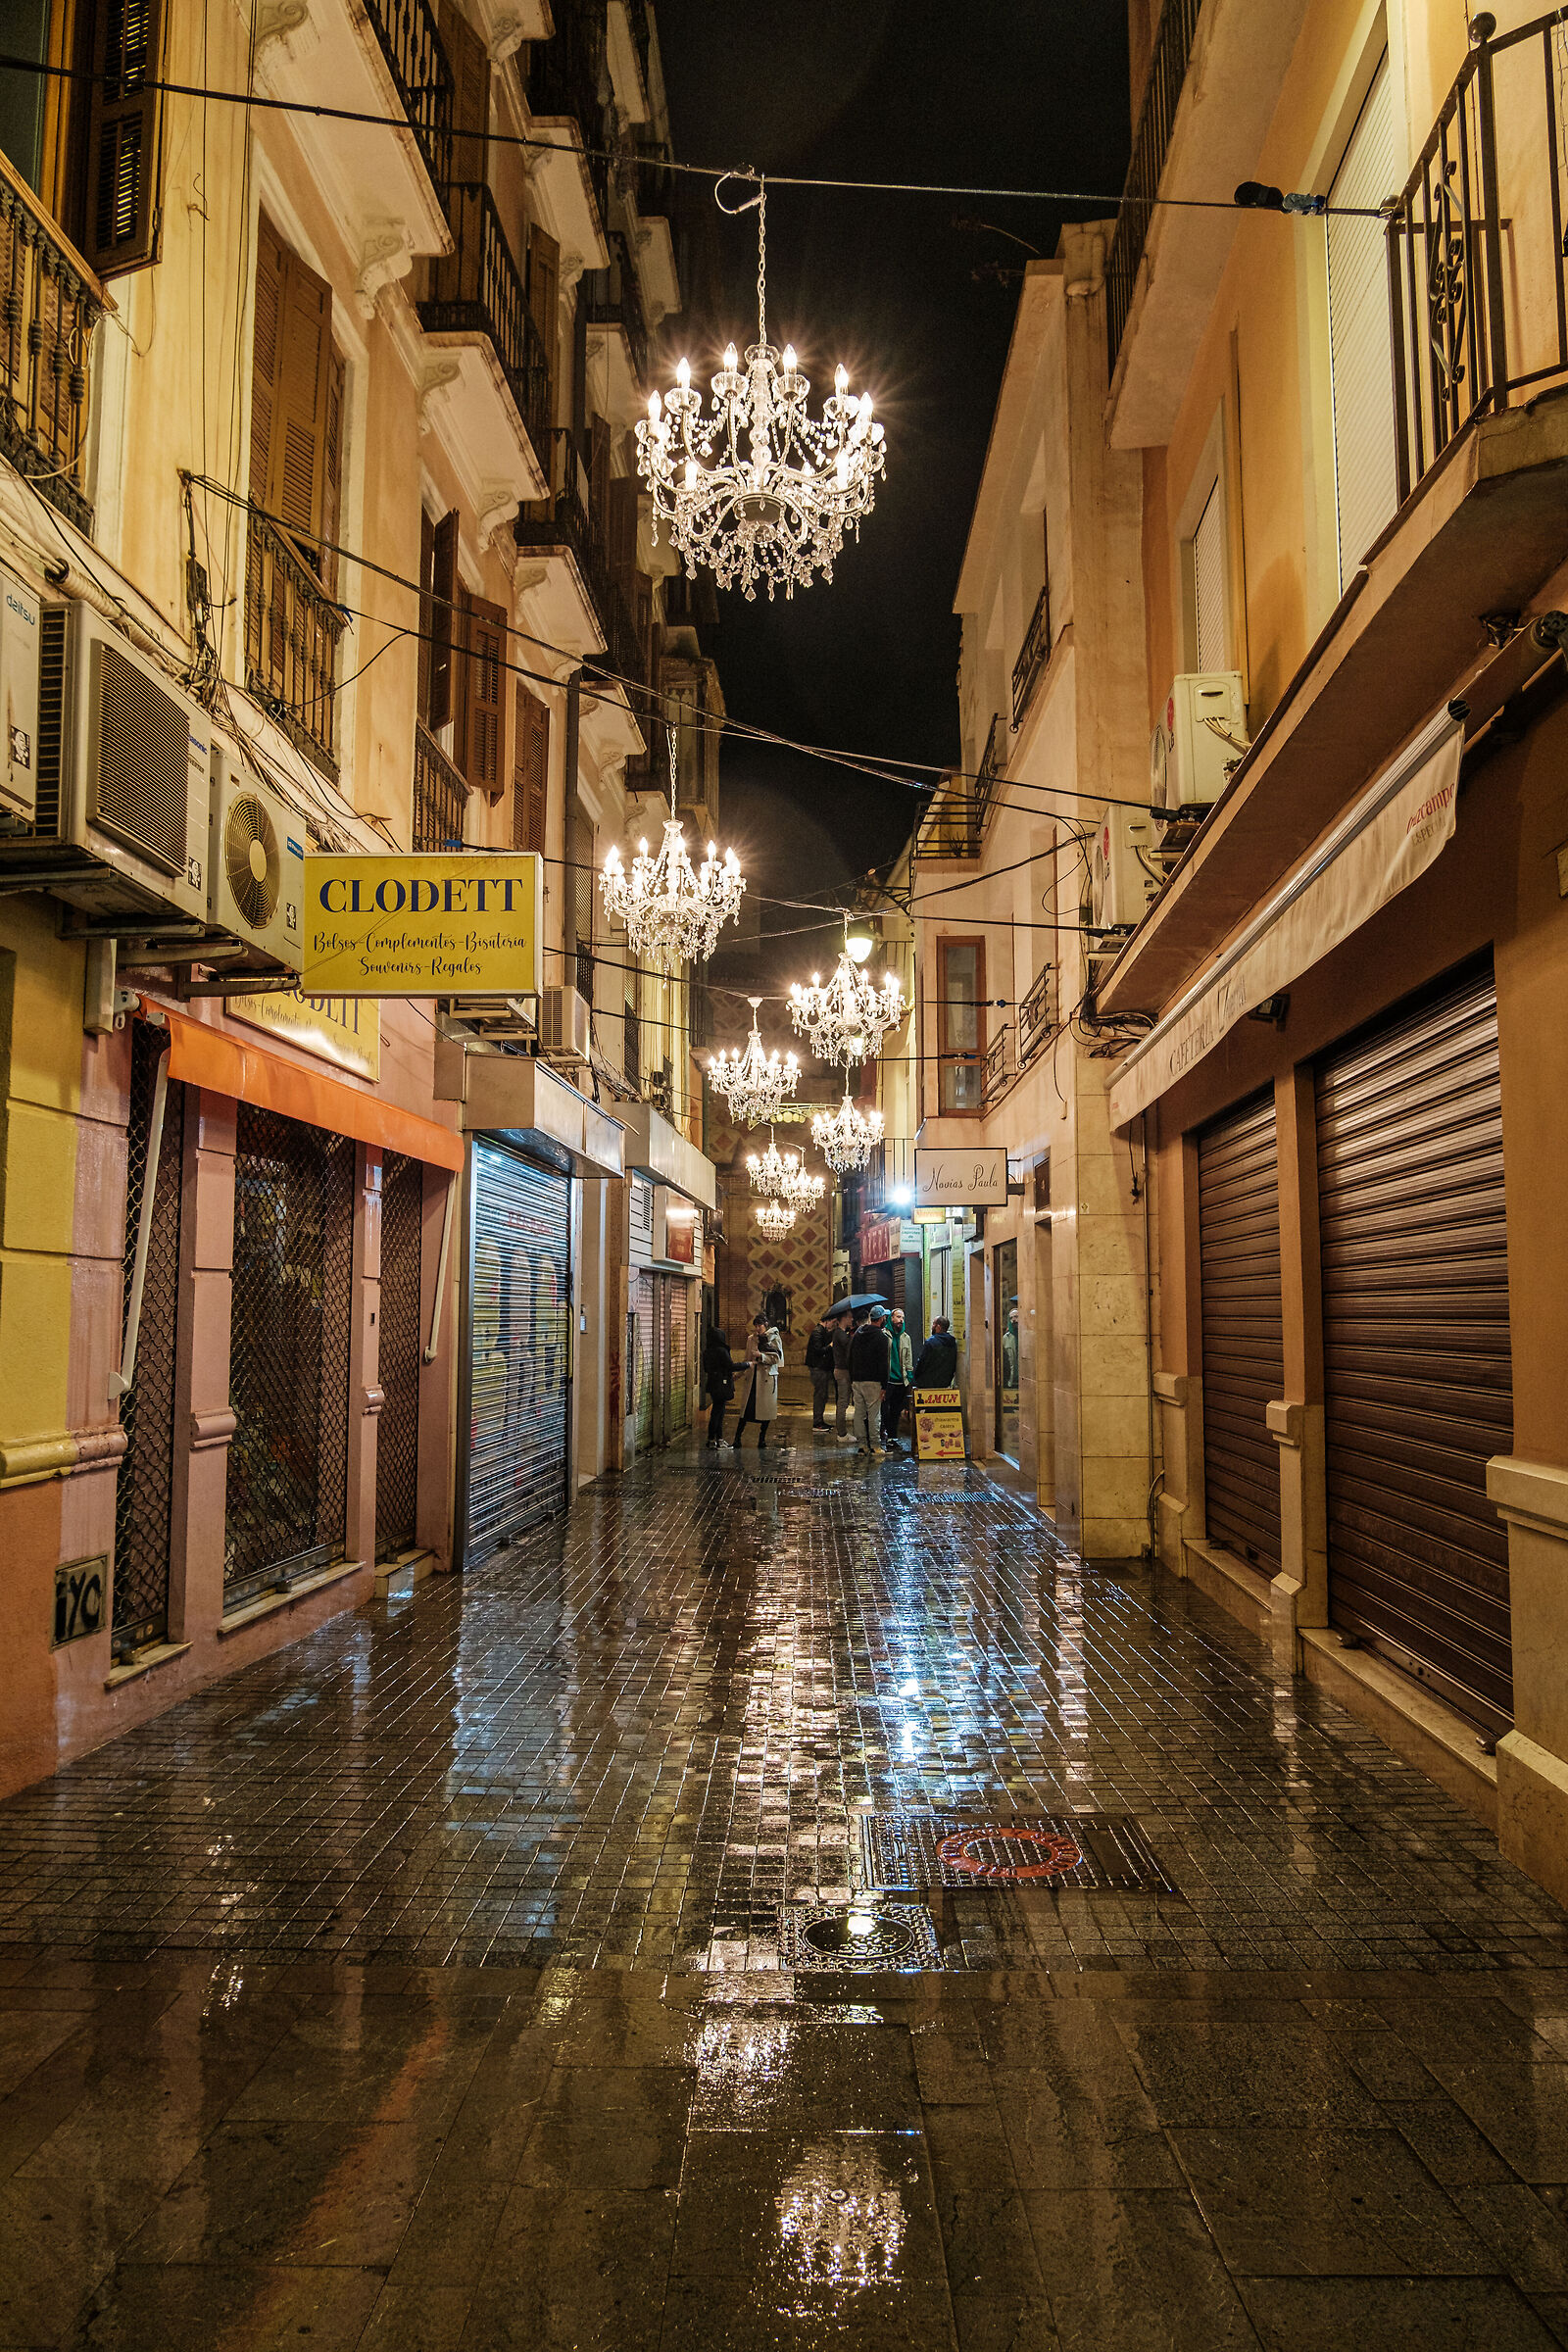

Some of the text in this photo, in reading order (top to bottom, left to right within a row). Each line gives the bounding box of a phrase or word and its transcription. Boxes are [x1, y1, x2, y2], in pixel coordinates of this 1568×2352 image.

[6, 594, 35, 625] daitsu
[319, 879, 522, 912] CLODETT
[922, 1163, 998, 1192] Novias Paula
[924, 1394, 958, 1404] AMUN
